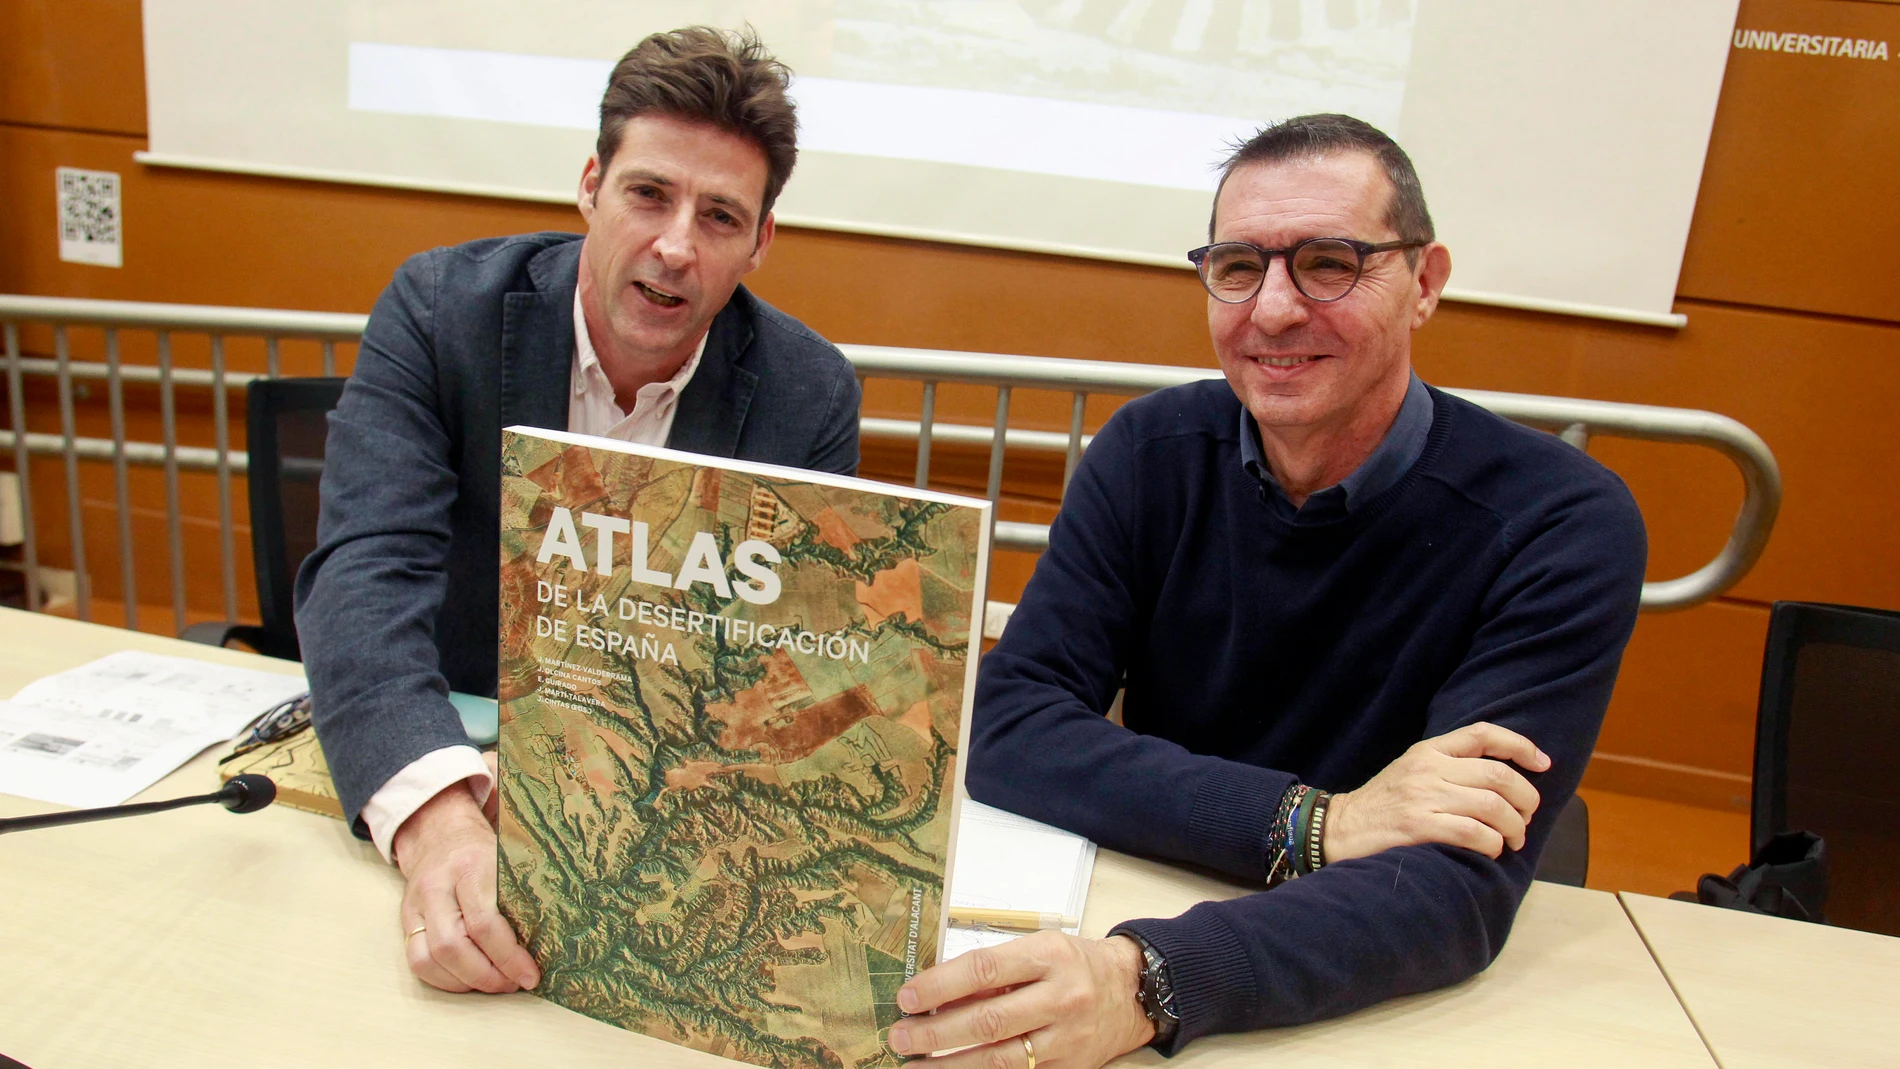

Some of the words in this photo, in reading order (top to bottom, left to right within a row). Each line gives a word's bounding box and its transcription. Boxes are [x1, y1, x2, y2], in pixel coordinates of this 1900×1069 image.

[1734, 29, 1888, 61] UNIVERSITARIA
[536, 506, 782, 605] ATLAS
[537, 580, 568, 608] DE
[577, 589, 609, 617] LA
[619, 597, 869, 664] DESERTIFICACIÓN
[537, 615, 567, 642] DE
[576, 624, 678, 666] ESPAÑA
[537, 675, 544, 683] E.
[545, 677, 577, 691] GUIRADO
[545, 657, 632, 683] MARTÍNEZ-VALDERRAMA
[545, 667, 571, 680] OLCINA
[572, 674, 602, 686] CANTOS
[544, 697, 570, 709] CINTAS
[909, 887, 922, 938] D'ALACANT
[904, 939, 918, 983] VERSITAT
